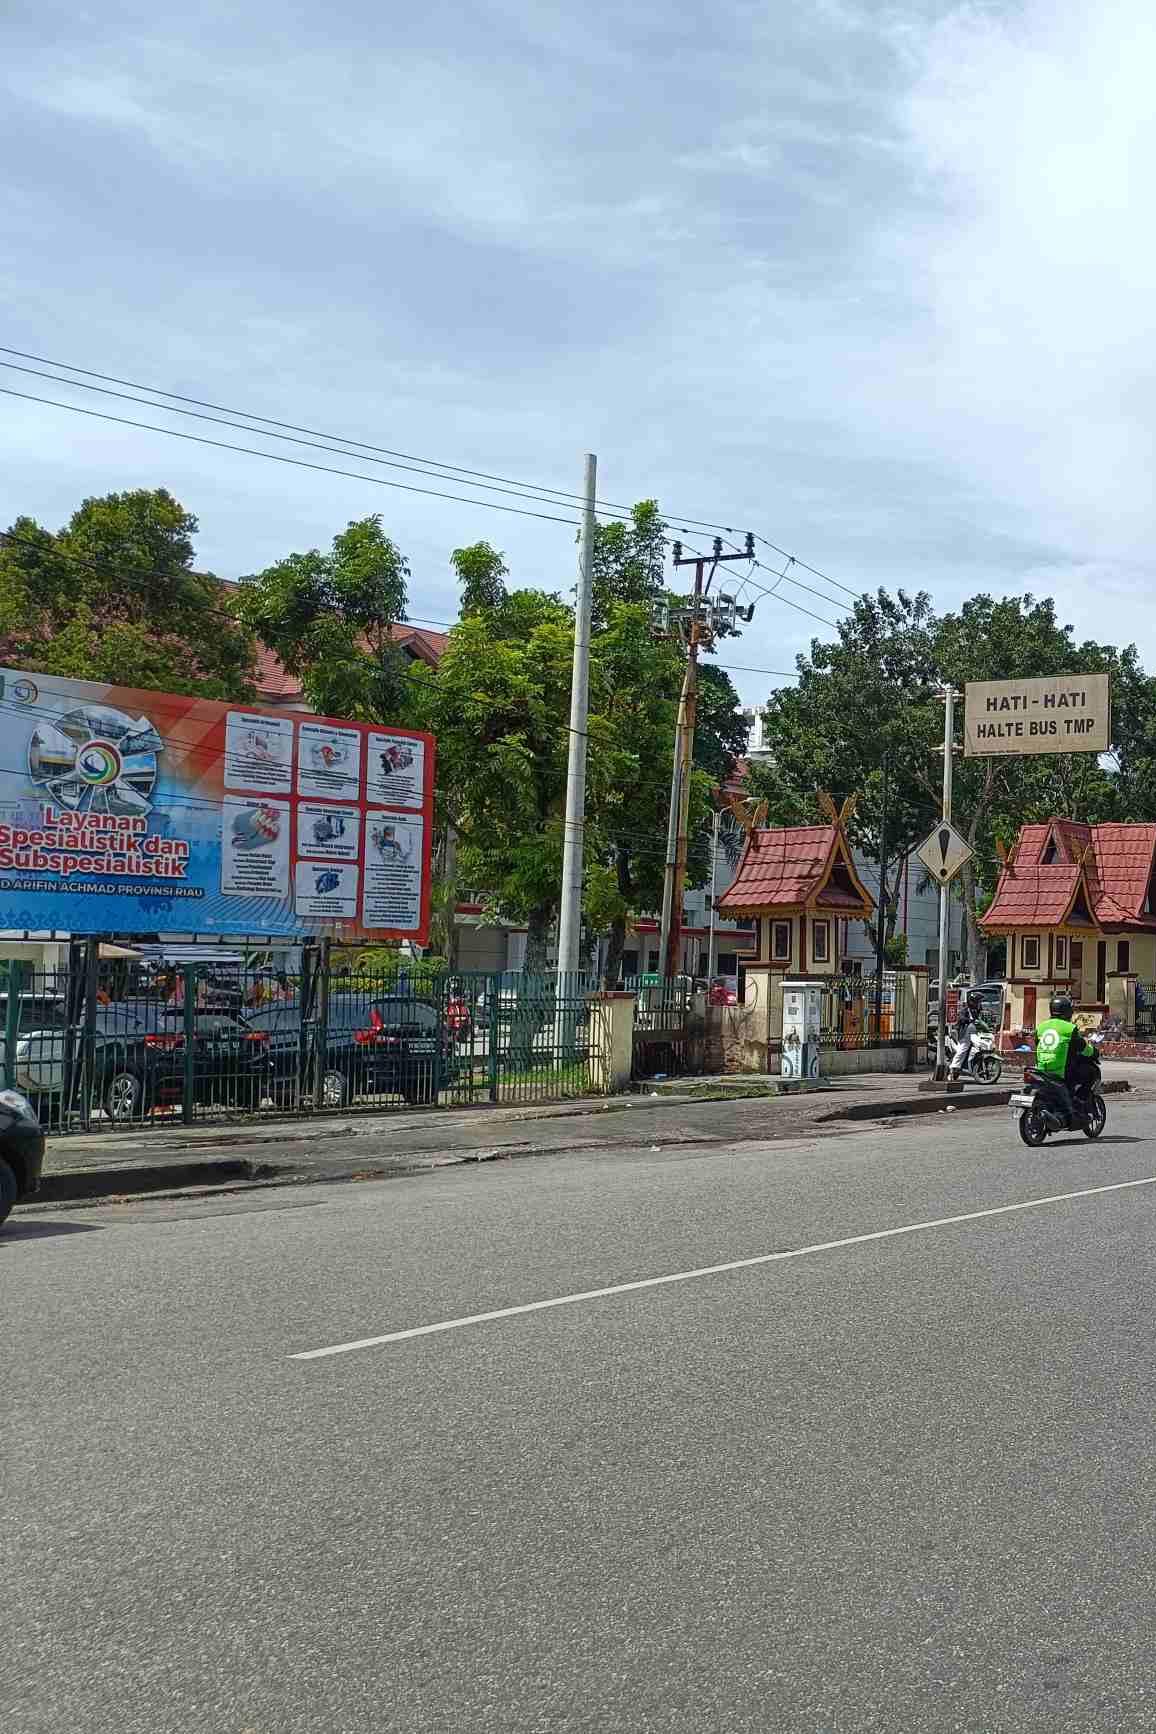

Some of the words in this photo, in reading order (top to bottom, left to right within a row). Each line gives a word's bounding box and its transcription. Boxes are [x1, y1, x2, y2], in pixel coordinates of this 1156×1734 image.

[986, 695, 1027, 712] HATI
[1044, 692, 1086, 708] HATI
[977, 721, 1023, 738] HALTE
[1029, 720, 1057, 735] BUS
[1064, 718, 1094, 734] TMP
[45, 806, 147, 833] Layanan
[0, 824, 140, 853] Spesialistik
[143, 834, 188, 857] dan
[0, 848, 186, 877] Subspesialistik
[13, 880, 57, 891] ARIFIN
[60, 882, 116, 894] ACHMAD
[118, 885, 173, 896] PROVINSI
[175, 887, 202, 897] RIAU
